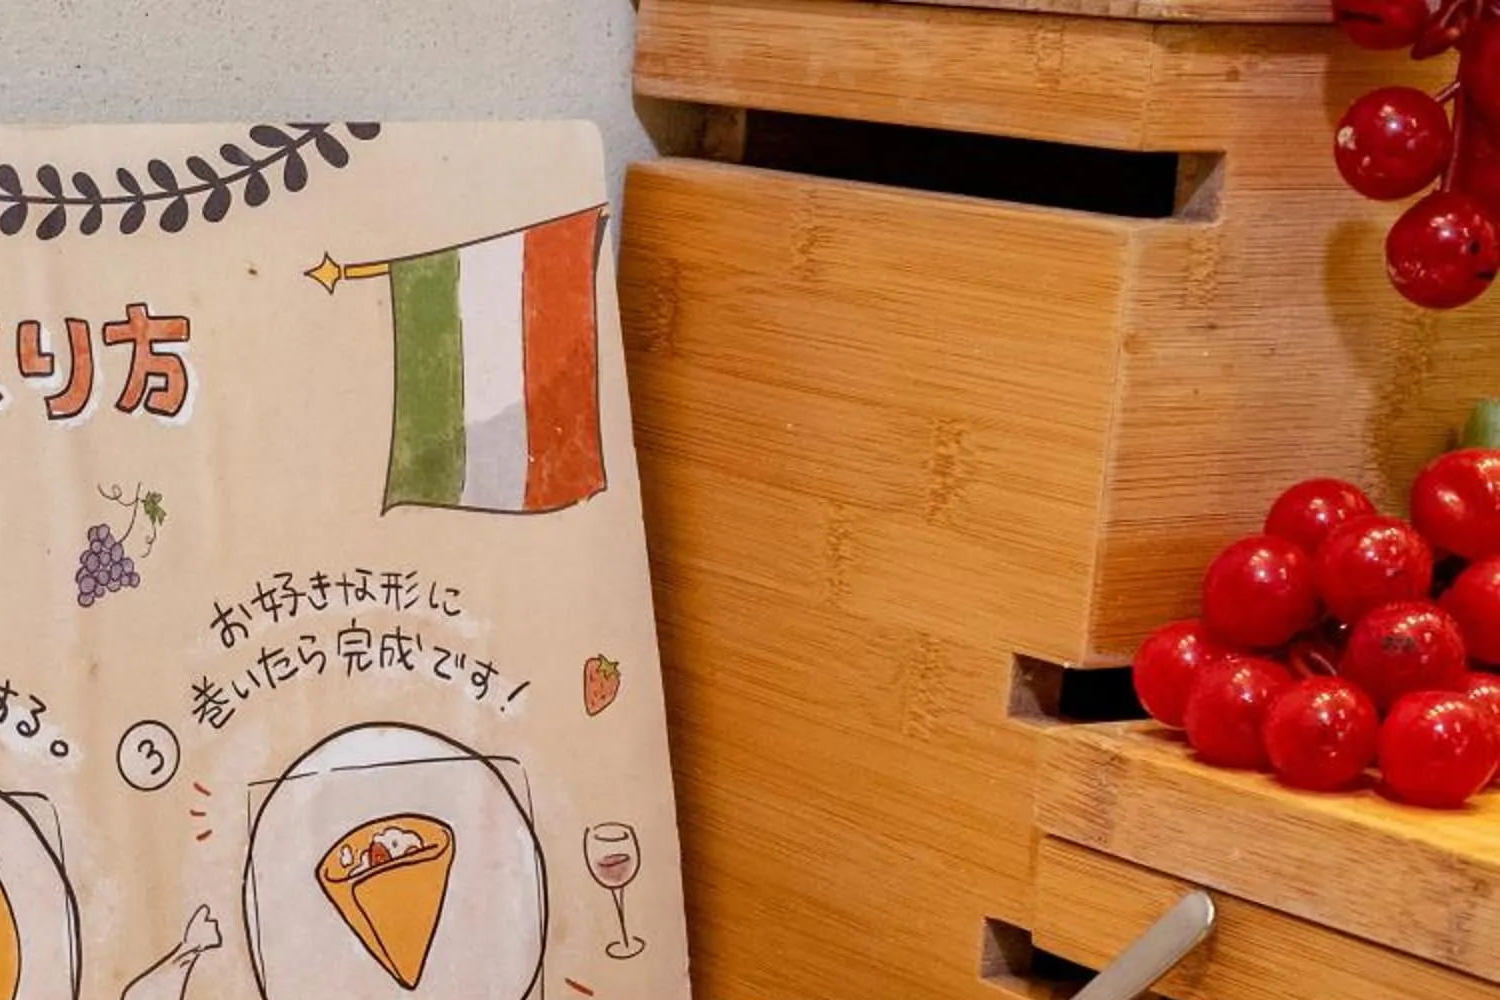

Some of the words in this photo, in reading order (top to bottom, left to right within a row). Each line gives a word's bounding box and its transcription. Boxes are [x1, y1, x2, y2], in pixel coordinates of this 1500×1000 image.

[209, 568, 462, 649] お好きな形に
